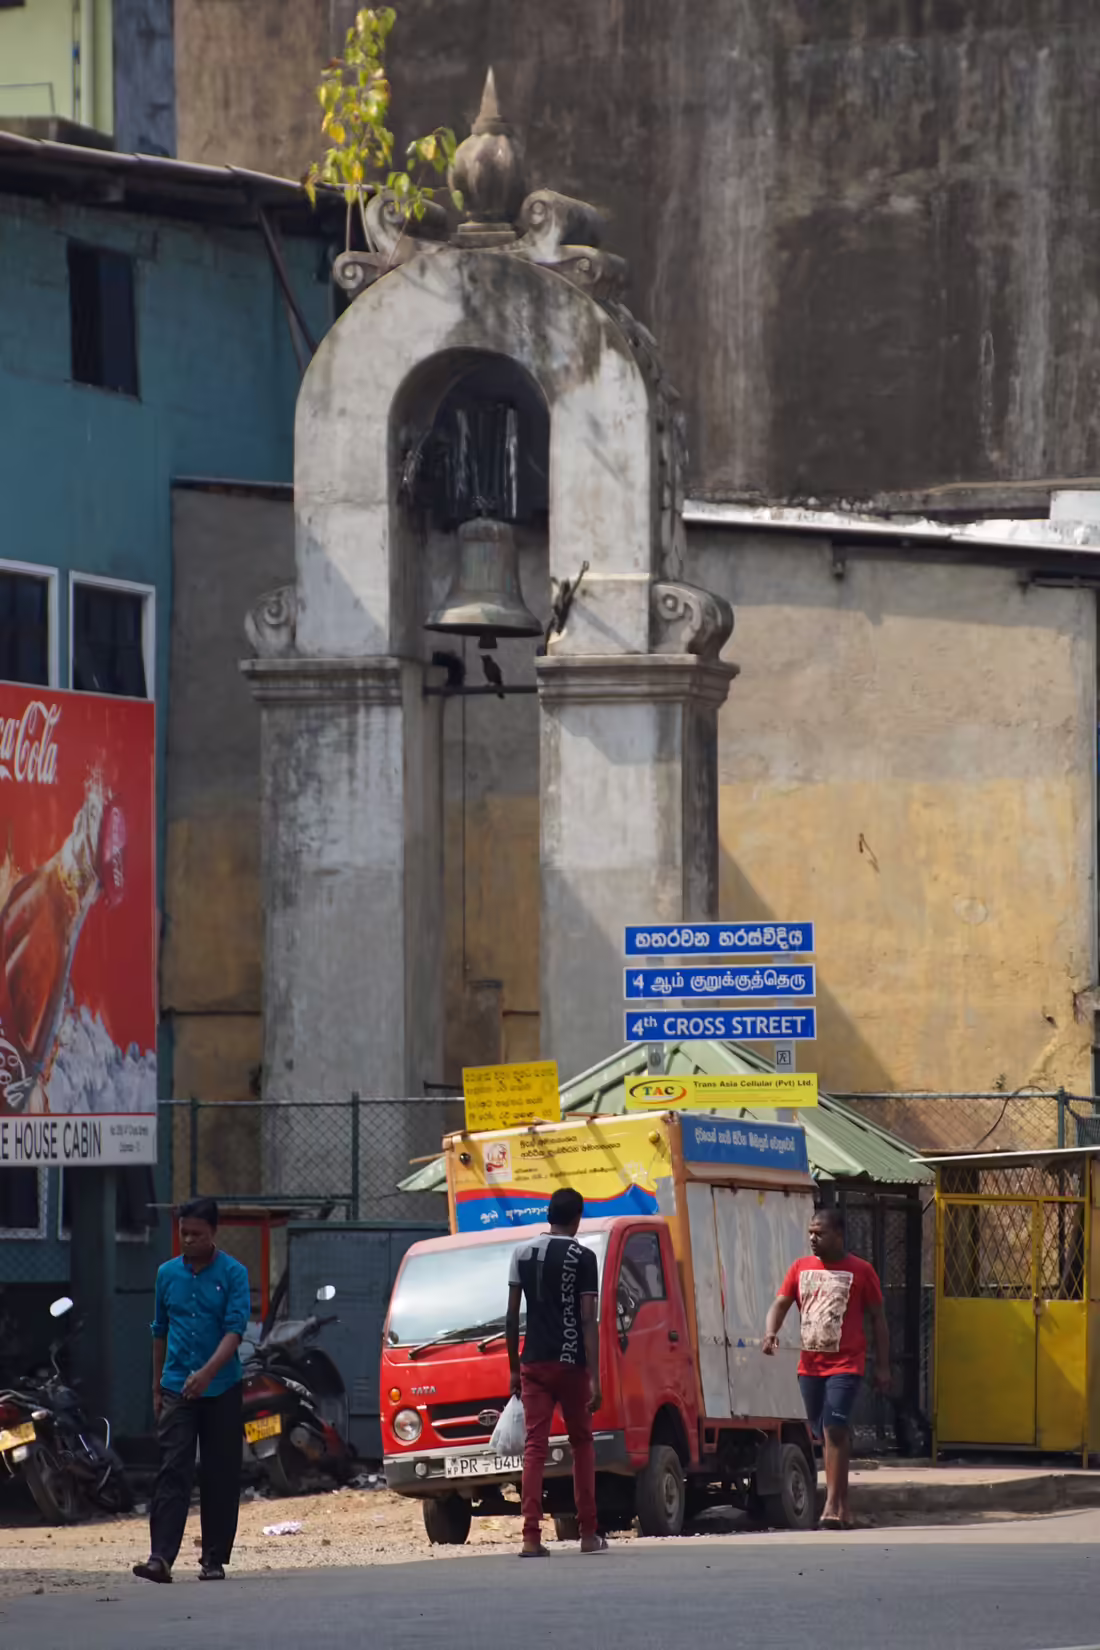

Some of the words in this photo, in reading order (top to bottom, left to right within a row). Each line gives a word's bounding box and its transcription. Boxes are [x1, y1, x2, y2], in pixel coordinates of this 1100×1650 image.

[632, 973, 645, 991] 4
[651, 972, 684, 993] ஆம்
[690, 969, 806, 991] குறுக்குத்தெரு
[632, 1016, 658, 1037] 4th
[663, 1017, 725, 1036] CROSS
[731, 1015, 807, 1035] STREET
[642, 1086, 675, 1097] TAC
[693, 1080, 717, 1089] Trans
[719, 1080, 738, 1089] Asia
[740, 1079, 773, 1088] Cellular
[775, 1079, 795, 1089] (Pvt)
[797, 1079, 814, 1088] Ltd.
[0, 1122, 9, 1160] E
[14, 1121, 58, 1160] HOUSE
[63, 1120, 102, 1159] CABIN
[559, 1243, 582, 1365] PROGRESSIVE
[410, 1385, 436, 1395] TATA
[460, 1458, 478, 1474] PR
